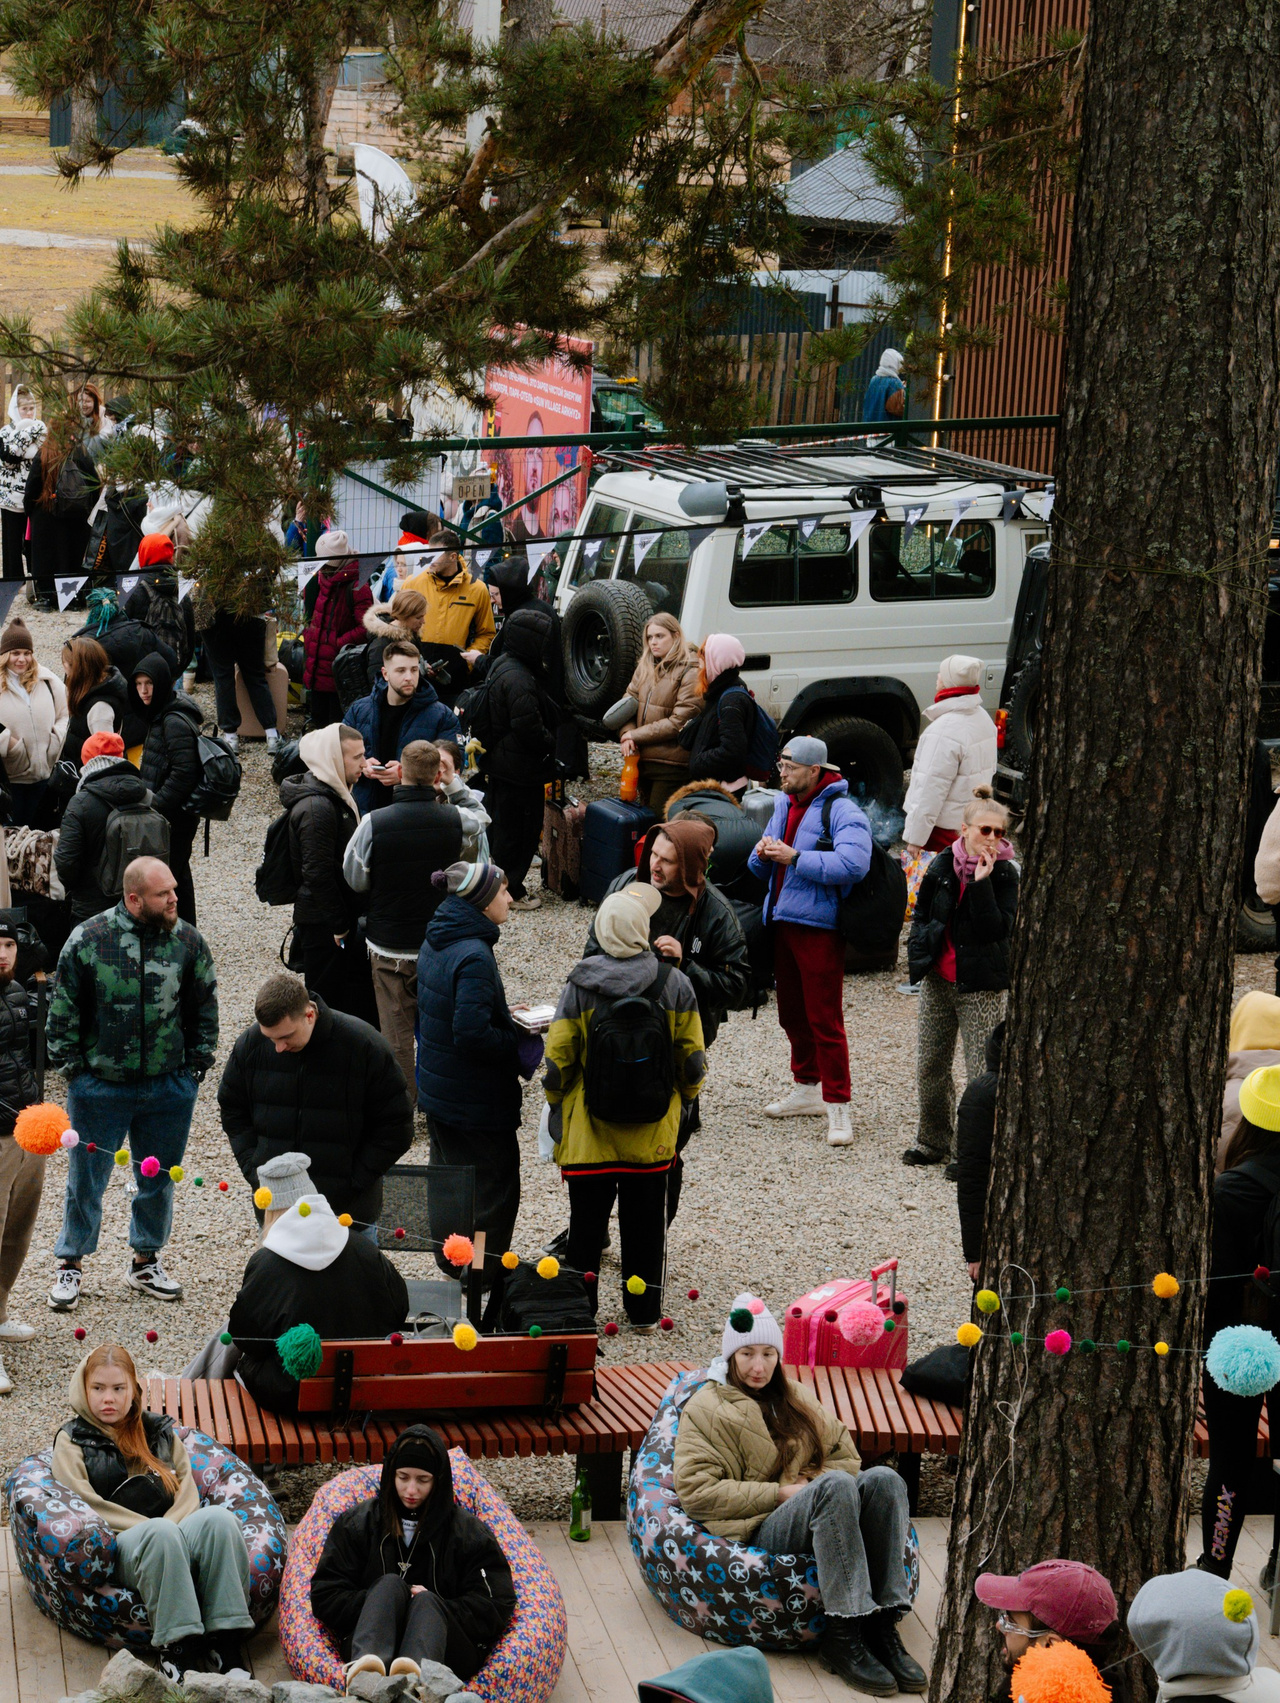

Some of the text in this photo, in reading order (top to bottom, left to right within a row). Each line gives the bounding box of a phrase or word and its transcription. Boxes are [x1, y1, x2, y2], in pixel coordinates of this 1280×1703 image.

[509, 386, 533, 403] ПАРК-ОТЕЛЬ
[545, 399, 561, 414] VILLAGE
[458, 485, 485, 498] OPEN
